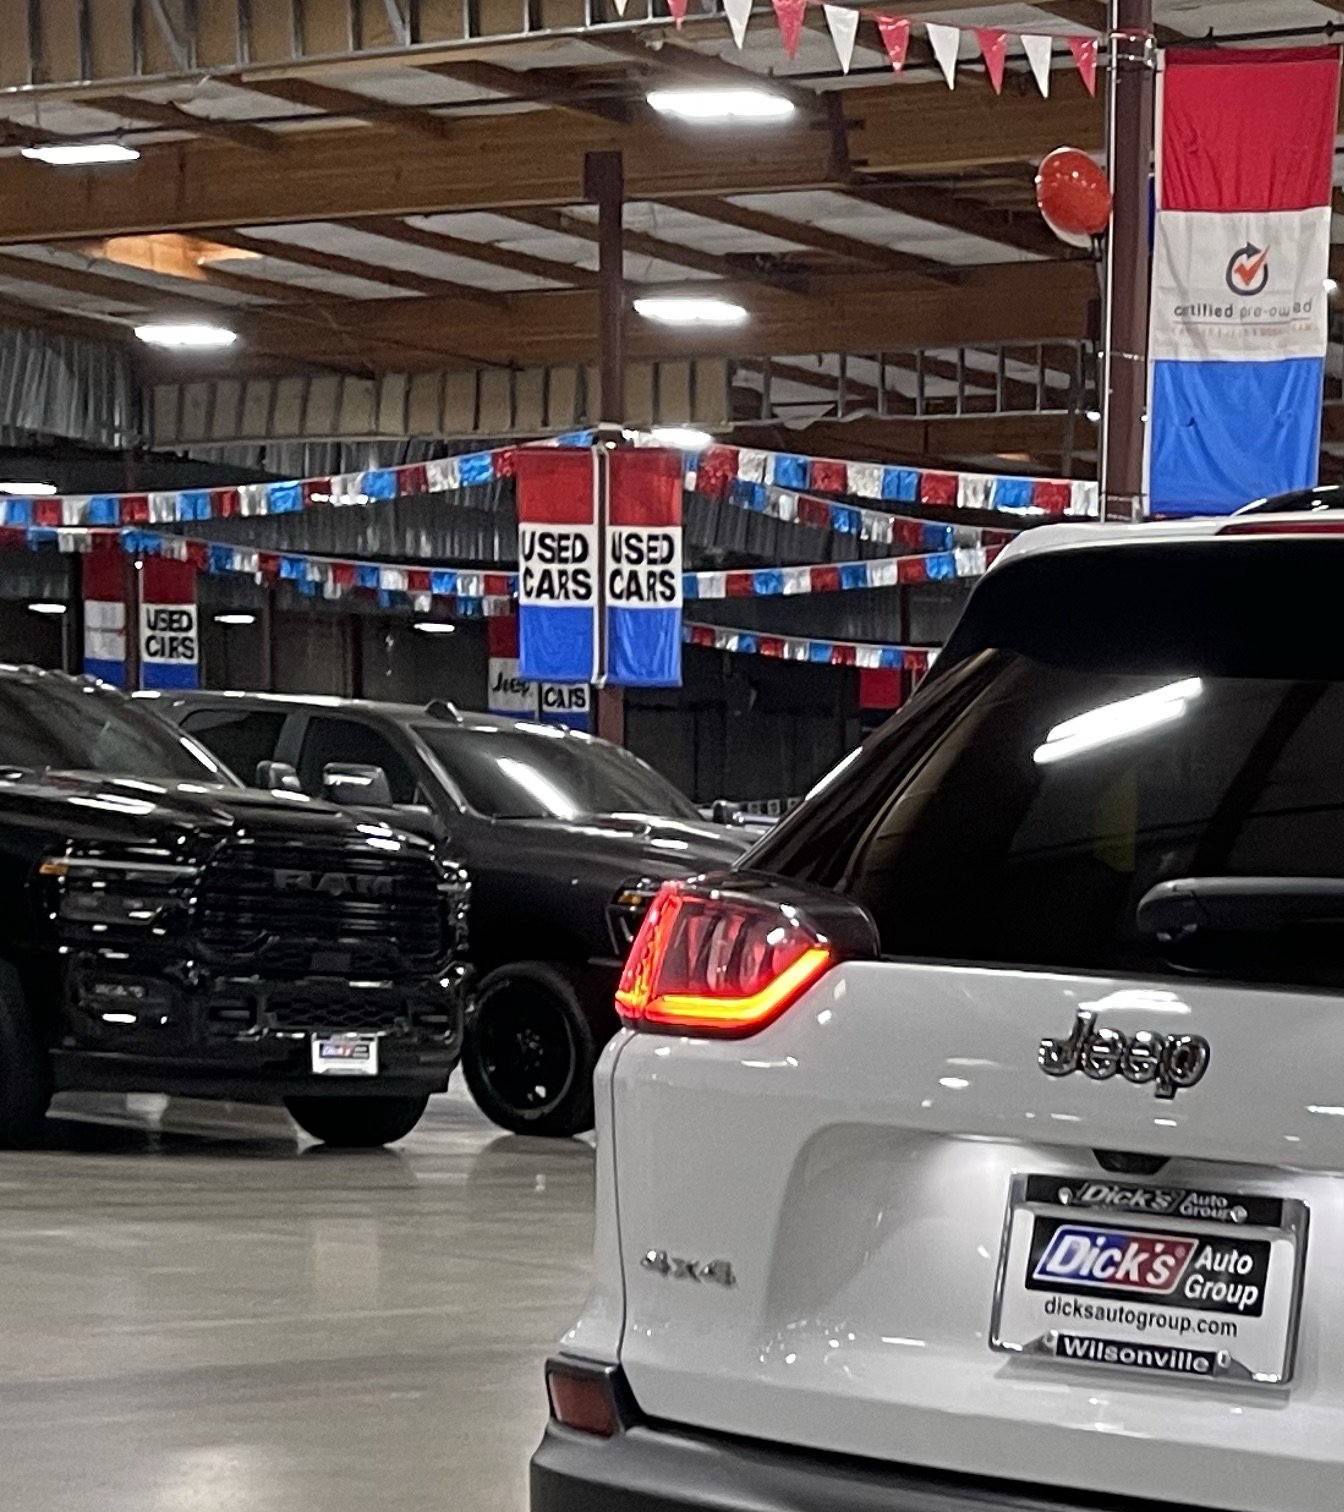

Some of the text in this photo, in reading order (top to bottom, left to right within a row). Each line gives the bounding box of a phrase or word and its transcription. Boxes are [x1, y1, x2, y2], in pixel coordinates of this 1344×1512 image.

[522, 531, 589, 564] USED
[611, 532, 675, 565] USED
[523, 566, 592, 601] CARS
[609, 568, 676, 603] CARS
[146, 608, 193, 633] USED
[1038, 1009, 1211, 1100] Jeep
[1184, 1192, 1228, 1208] Auto
[1045, 1235, 1254, 1286] Dick's Auto
[1184, 1274, 1259, 1311] Group
[1044, 1297, 1238, 1337] dicksautogroup.com
[1063, 1336, 1210, 1373] Wilsonville
